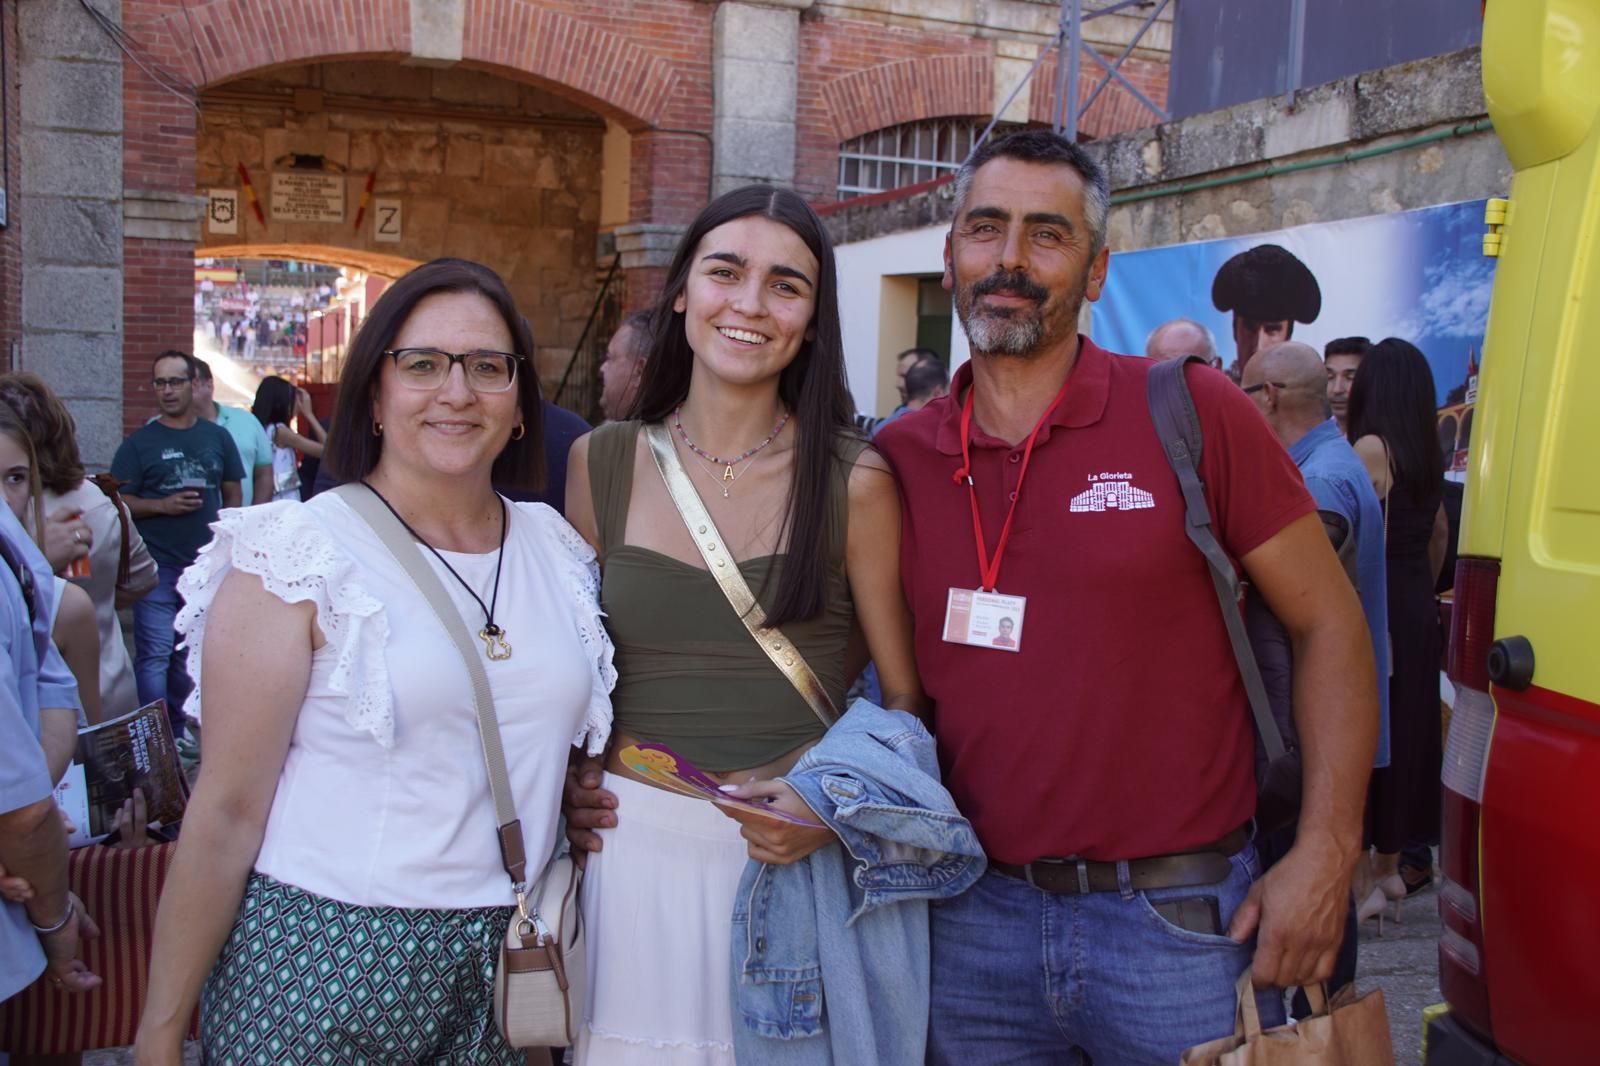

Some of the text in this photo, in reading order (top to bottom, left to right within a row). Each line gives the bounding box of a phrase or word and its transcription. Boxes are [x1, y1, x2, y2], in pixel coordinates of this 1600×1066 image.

[723, 465, 735, 480] A
[1100, 472, 1133, 480] Glorieta
[128, 722, 137, 738] LA
[141, 715, 152, 738] QUE
[135, 718, 151, 773] MEREZCA
